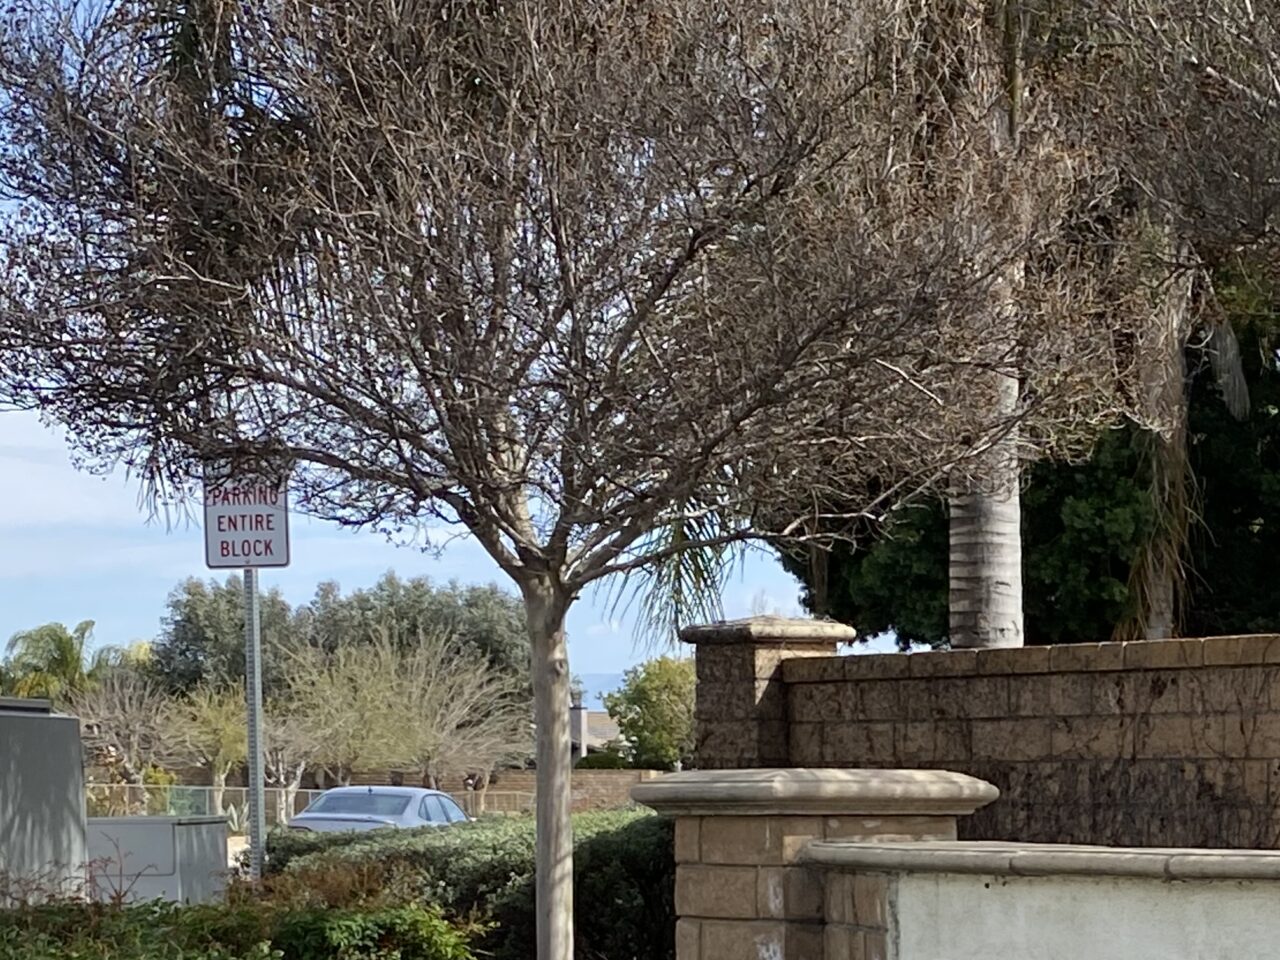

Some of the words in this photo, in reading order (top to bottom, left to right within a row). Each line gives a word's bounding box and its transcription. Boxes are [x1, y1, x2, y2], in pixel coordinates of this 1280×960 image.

[212, 485, 279, 506] PARKING
[217, 514, 275, 532] ENTIRE
[220, 539, 274, 558] BLOCK
